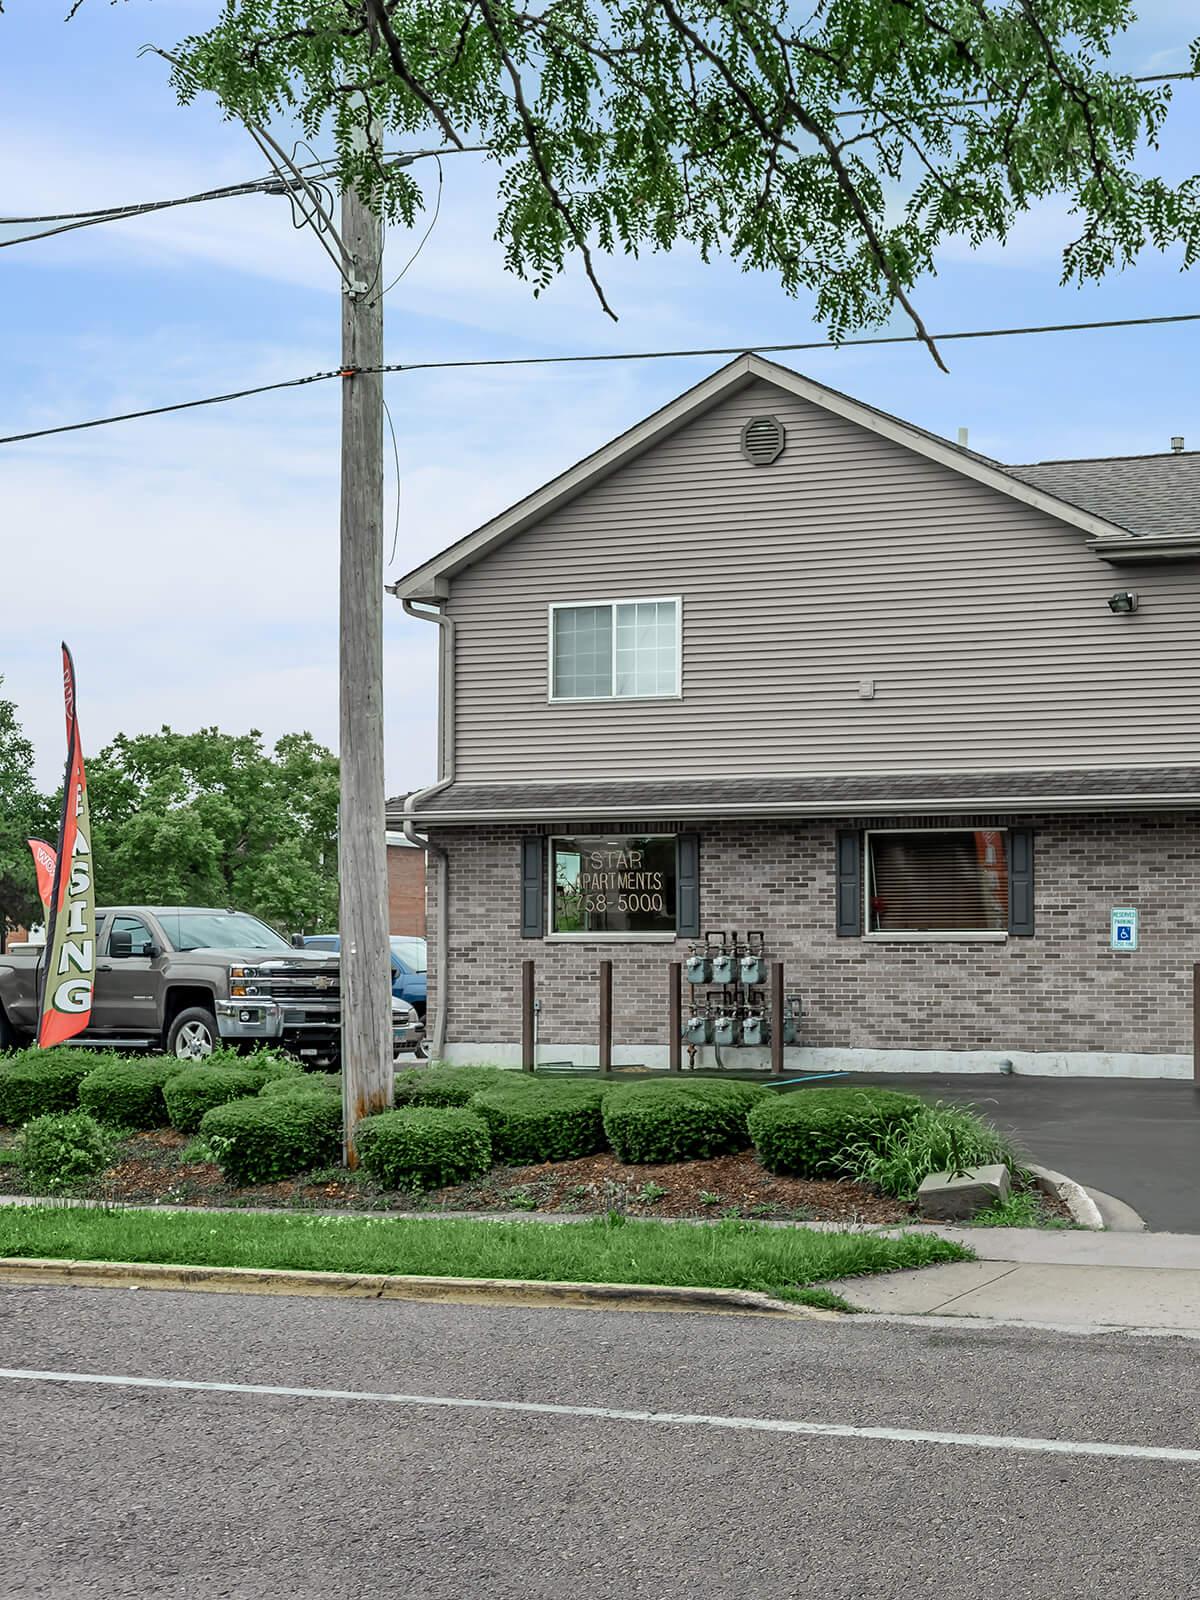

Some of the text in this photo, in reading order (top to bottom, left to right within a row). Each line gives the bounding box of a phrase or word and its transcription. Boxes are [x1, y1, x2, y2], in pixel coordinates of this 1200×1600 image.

[591, 851, 642, 870] STAR
[576, 872, 662, 890] APARTMENTS
[576, 894, 663, 912] 758-5000
